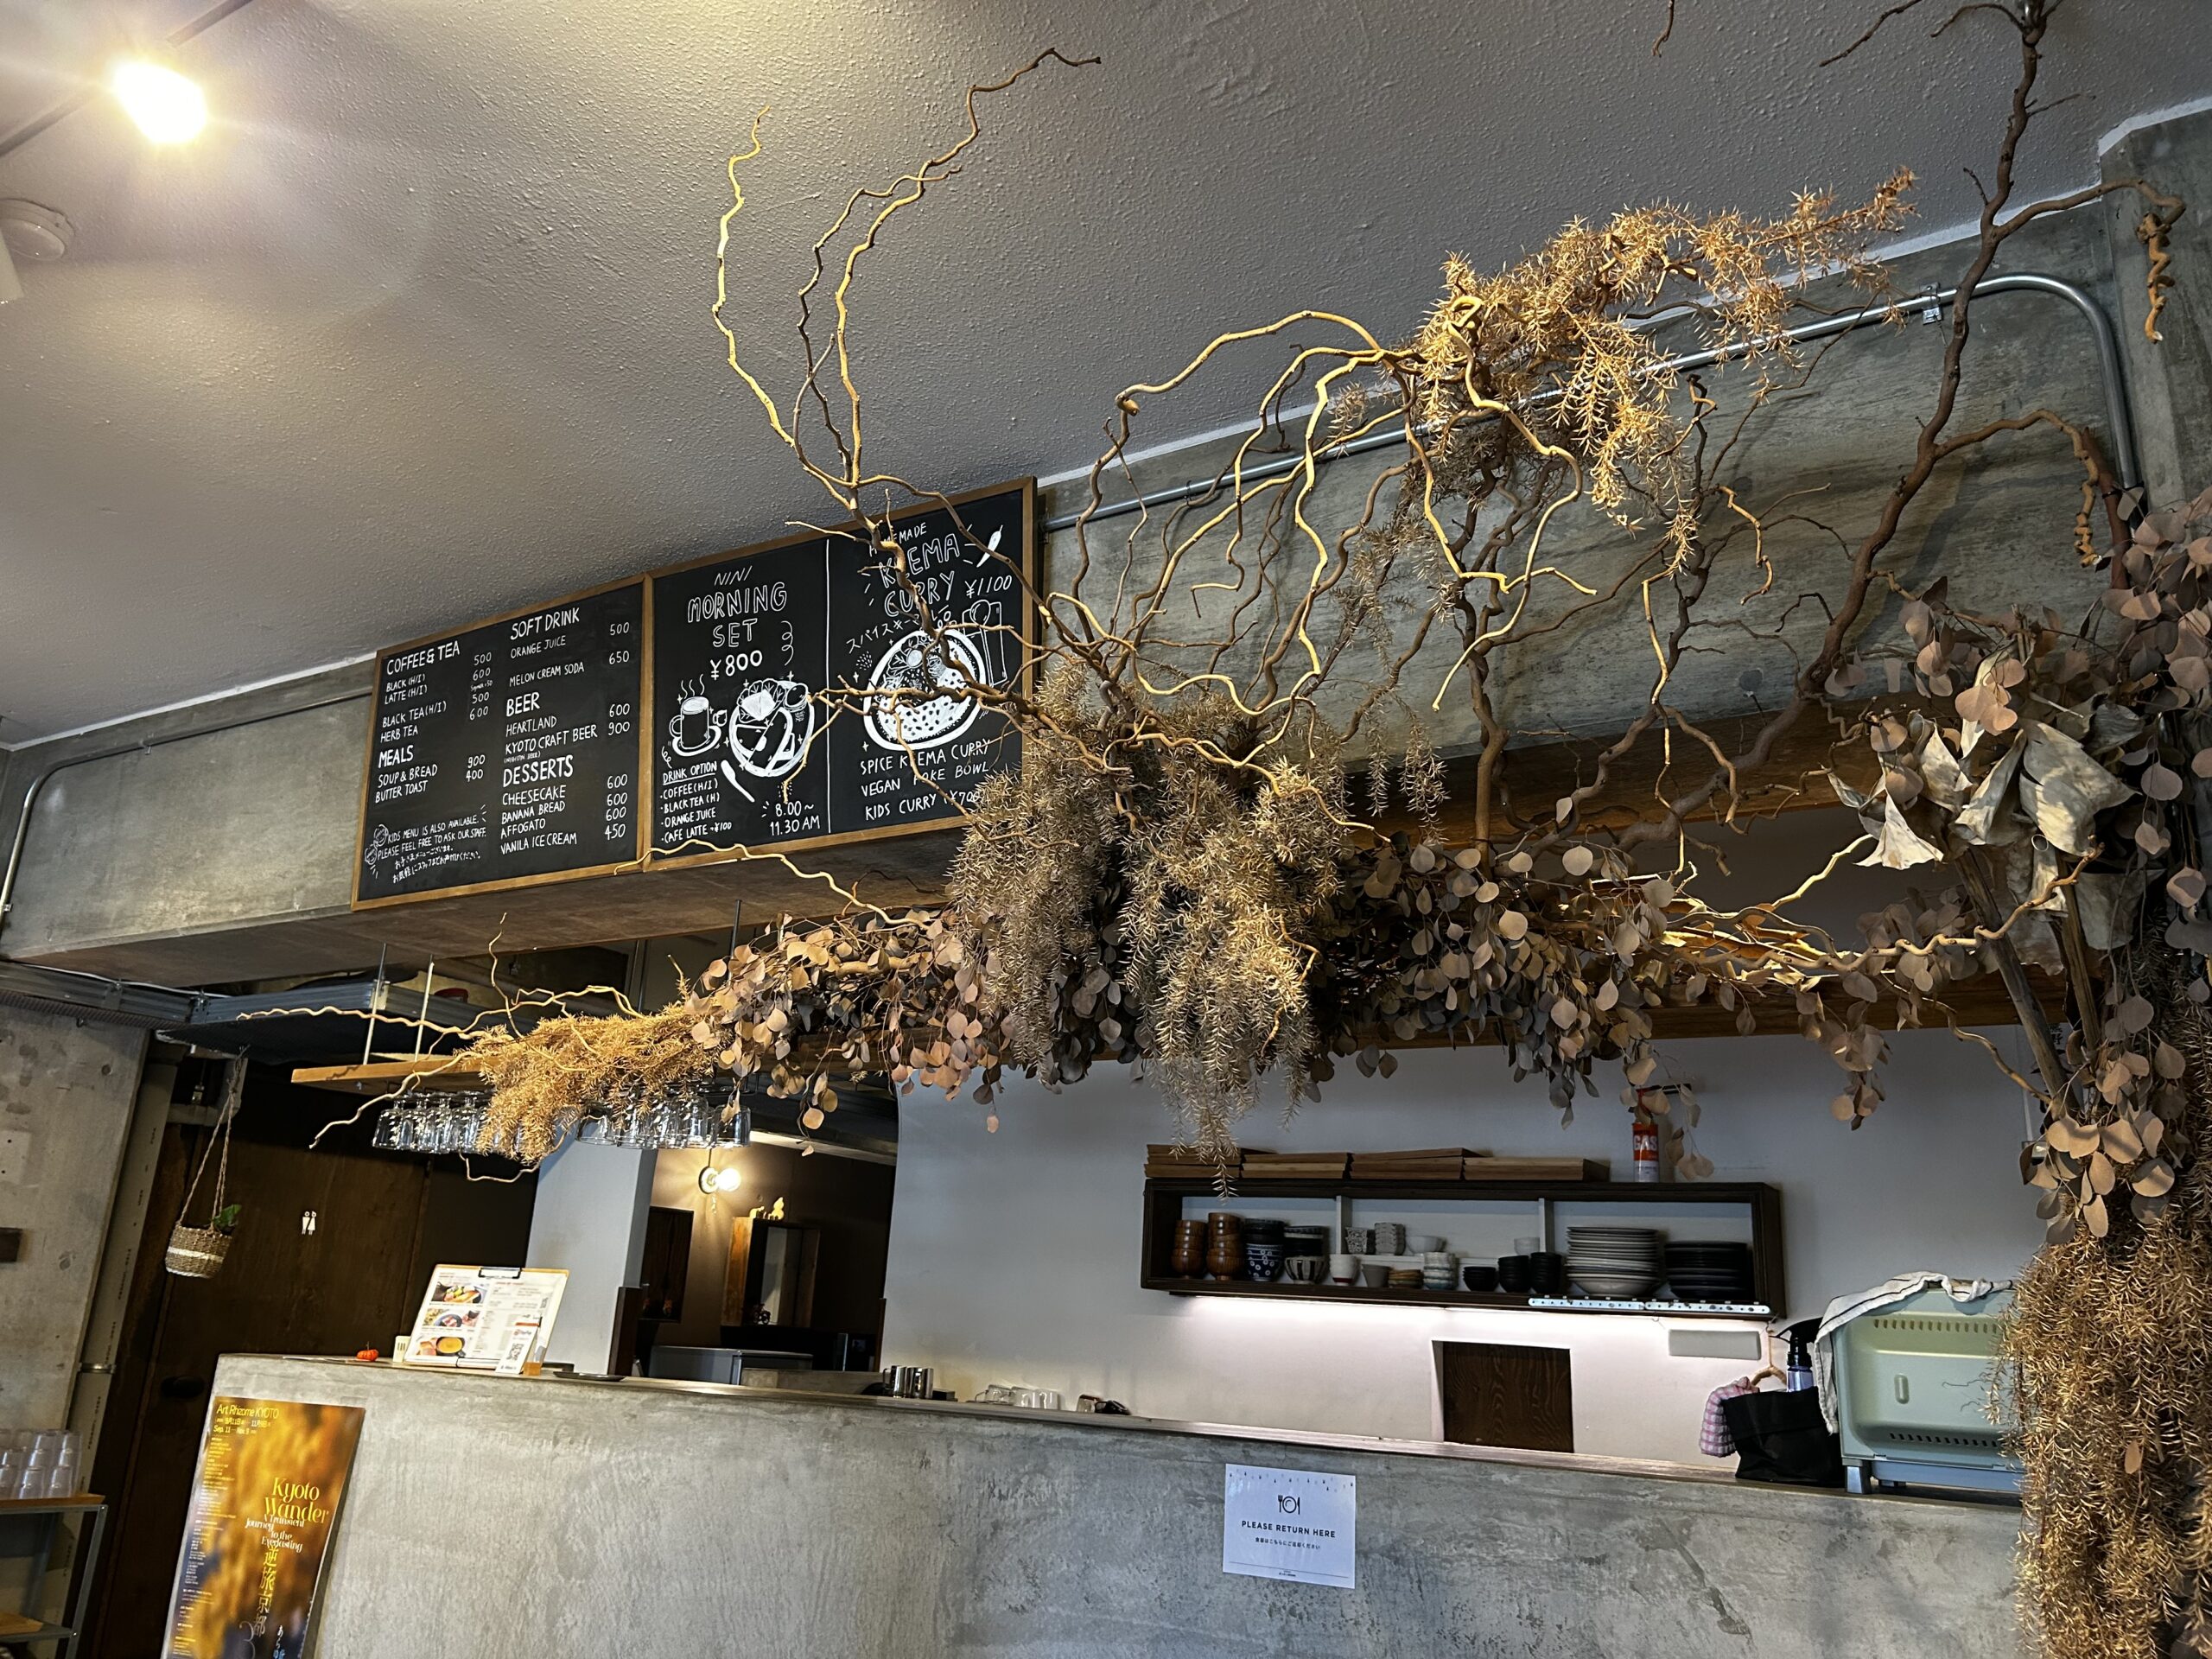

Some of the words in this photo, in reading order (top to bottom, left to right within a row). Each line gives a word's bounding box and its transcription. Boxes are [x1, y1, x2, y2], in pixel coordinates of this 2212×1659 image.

[879, 533, 960, 588] KEMA
[714, 565, 753, 586] NINI
[964, 575, 1013, 599] ¥1100
[688, 582, 787, 623] MORNING
[510, 615, 543, 640] SOFT
[544, 607, 580, 632] DRINK
[712, 618, 758, 647] SET
[437, 640, 461, 661] TEA
[510, 641, 542, 659] ORANGE
[543, 635, 567, 650] JUICE
[609, 621, 630, 636] 500
[385, 679, 407, 692] BLACK
[474, 652, 493, 666] 500
[509, 671, 535, 687] MELON
[537, 665, 562, 680] CREAM
[564, 661, 585, 676] SODA
[608, 650, 630, 665] 650
[709, 650, 763, 681] ¥800
[385, 690, 407, 704] LATTE
[473, 667, 491, 681] 600
[382, 712, 406, 728] BLACK
[472, 691, 490, 704] 500
[505, 691, 541, 717] BEER
[380, 728, 401, 743] HERB
[403, 725, 419, 738] TEA
[469, 706, 489, 721] 600
[505, 715, 557, 738] HEARTLAND
[609, 702, 631, 718] 600
[505, 738, 537, 755] KYOTO
[537, 730, 569, 749] CRAFT
[572, 724, 598, 742] BEER
[607, 721, 631, 736] 900
[378, 745, 414, 768] MEALS
[409, 764, 438, 781] BREAD
[467, 754, 486, 768] 900
[503, 754, 574, 788] DESSERTS
[860, 755, 893, 775] SPICE
[899, 748, 946, 769] KEMA
[951, 738, 991, 760] CURRY
[375, 786, 403, 804] BUTTER
[405, 780, 429, 796] TOAST
[466, 769, 484, 782] 400
[663, 767, 688, 784] DRINK
[690, 760, 718, 776] OPTION
[861, 778, 900, 797] VEGAN
[955, 761, 989, 778] BOWL
[502, 785, 567, 806] CHEESECAKE
[607, 773, 628, 789] 600
[664, 800, 688, 813] BLACK
[690, 795, 705, 809] TEA
[706, 792, 721, 806] (H)
[501, 805, 535, 825] BANANA
[537, 800, 566, 816] BREAD
[607, 792, 628, 807] 600
[664, 811, 695, 828] ORANGE
[696, 807, 716, 821] JUICE
[865, 803, 891, 821] KIDS
[899, 793, 937, 814] CURRY
[387, 831, 401, 844] KIDS
[403, 828, 419, 840] MENU
[423, 827, 429, 836] IS
[429, 823, 446, 835] ALSO
[500, 817, 546, 840] AFFOGATO
[606, 806, 627, 822] 600
[664, 828, 683, 843] CAFE
[686, 823, 709, 839] LATTE
[770, 819, 800, 836] 11.30
[802, 815, 821, 830] AM
[377, 845, 400, 861] PLEASE
[401, 841, 416, 854] FEEL
[418, 836, 432, 849] FREE
[435, 835, 442, 844] TO
[442, 832, 456, 842] ASK
[500, 837, 530, 855] VANILA
[531, 835, 545, 848] ICE
[546, 832, 577, 846] CREAM
[605, 823, 626, 841] 450
[1633, 1135, 1657, 1152] GAS
[216, 1403, 229, 1414] Art
[229, 1404, 255, 1417] Rhizome
[255, 1407, 279, 1420] KYOTO
[272, 1477, 320, 1503] Kyoto
[245, 1517, 275, 1532] Journey
[264, 1497, 329, 1523] Wander
[269, 1514, 305, 1528] Transient
[270, 1530, 278, 1539] to
[279, 1530, 293, 1540] the
[1241, 1520, 1273, 1531] PLEASE
[1275, 1524, 1310, 1535] RETURN
[1313, 1529, 1336, 1538] HERE
[261, 1536, 303, 1554] Everlasting
